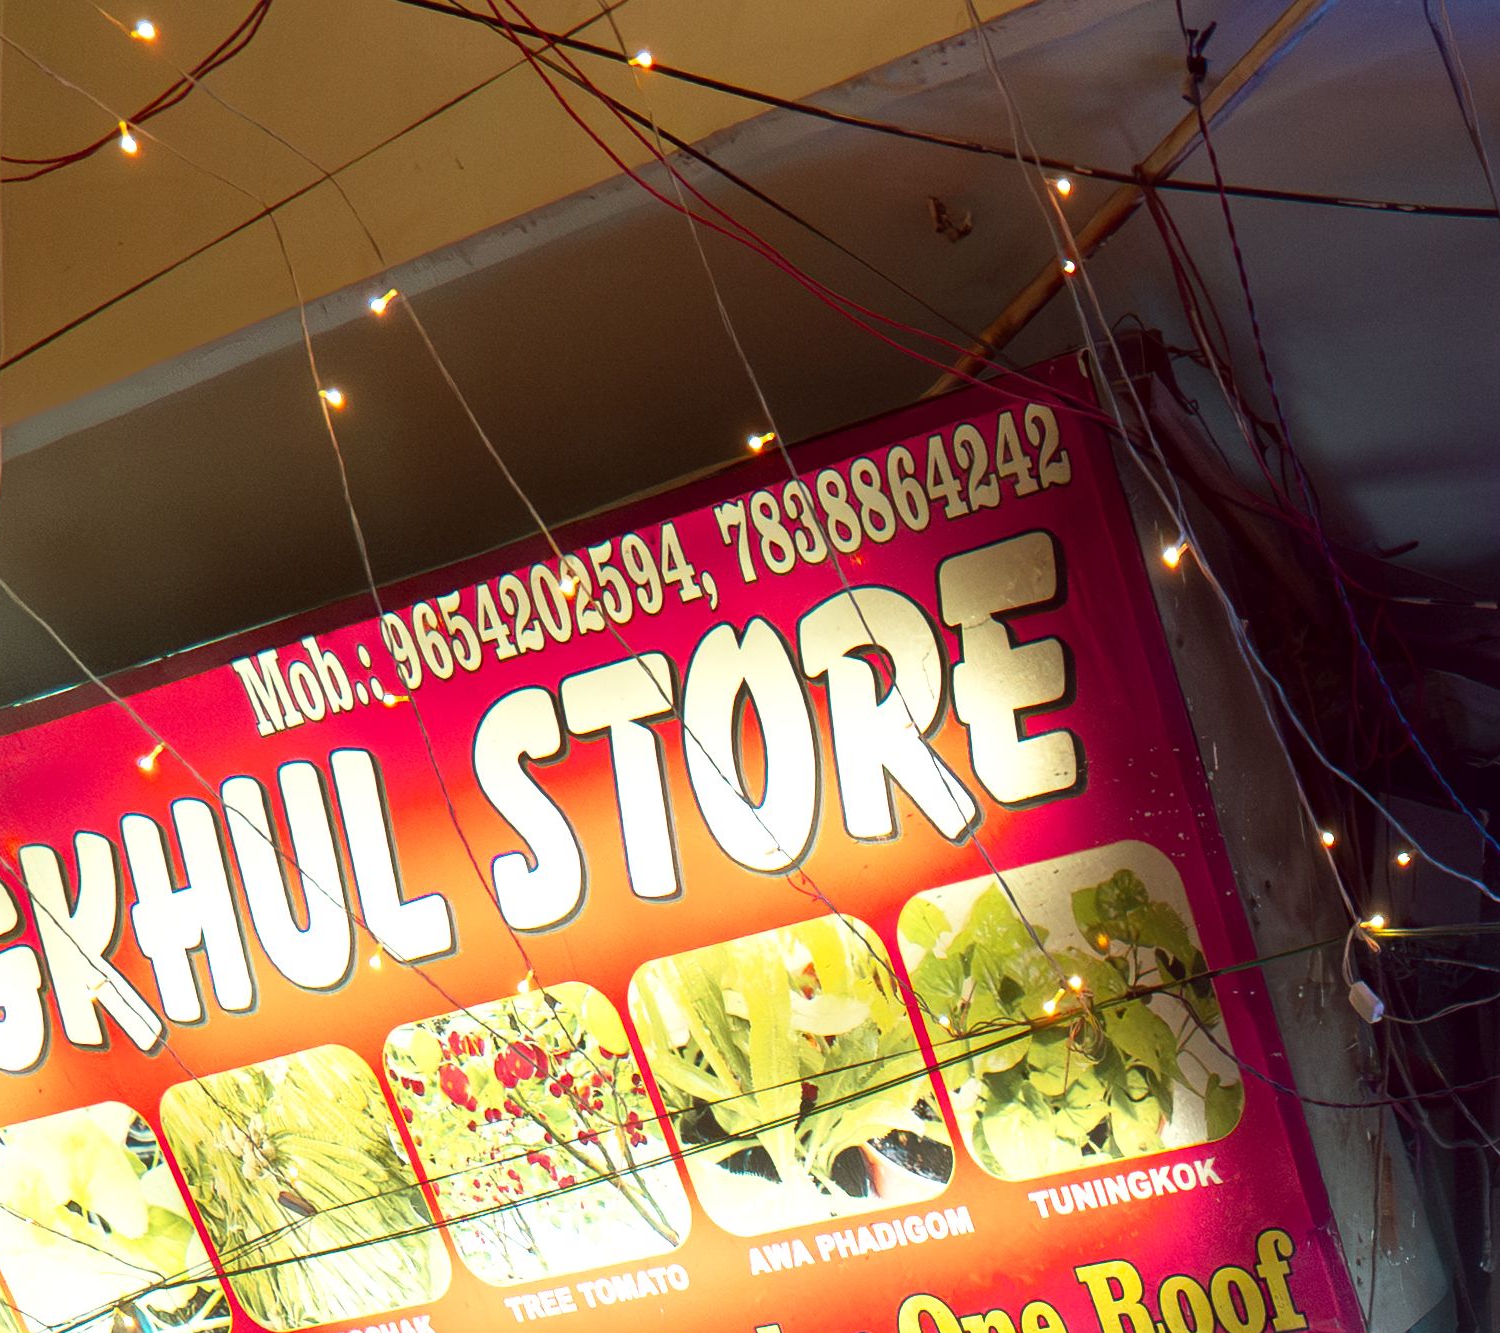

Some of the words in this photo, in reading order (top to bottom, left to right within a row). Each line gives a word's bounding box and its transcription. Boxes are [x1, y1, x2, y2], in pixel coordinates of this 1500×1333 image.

[713, 404, 1072, 583] 7838864242
[470, 528, 1089, 934] STORE
[1027, 1157, 1226, 1221] TUNINGKOK
[748, 1240, 815, 1277] AWA
[818, 1205, 976, 1263] PHADIGOM
[504, 1287, 579, 1324] TREE
[583, 1263, 691, 1310] TOMATO
